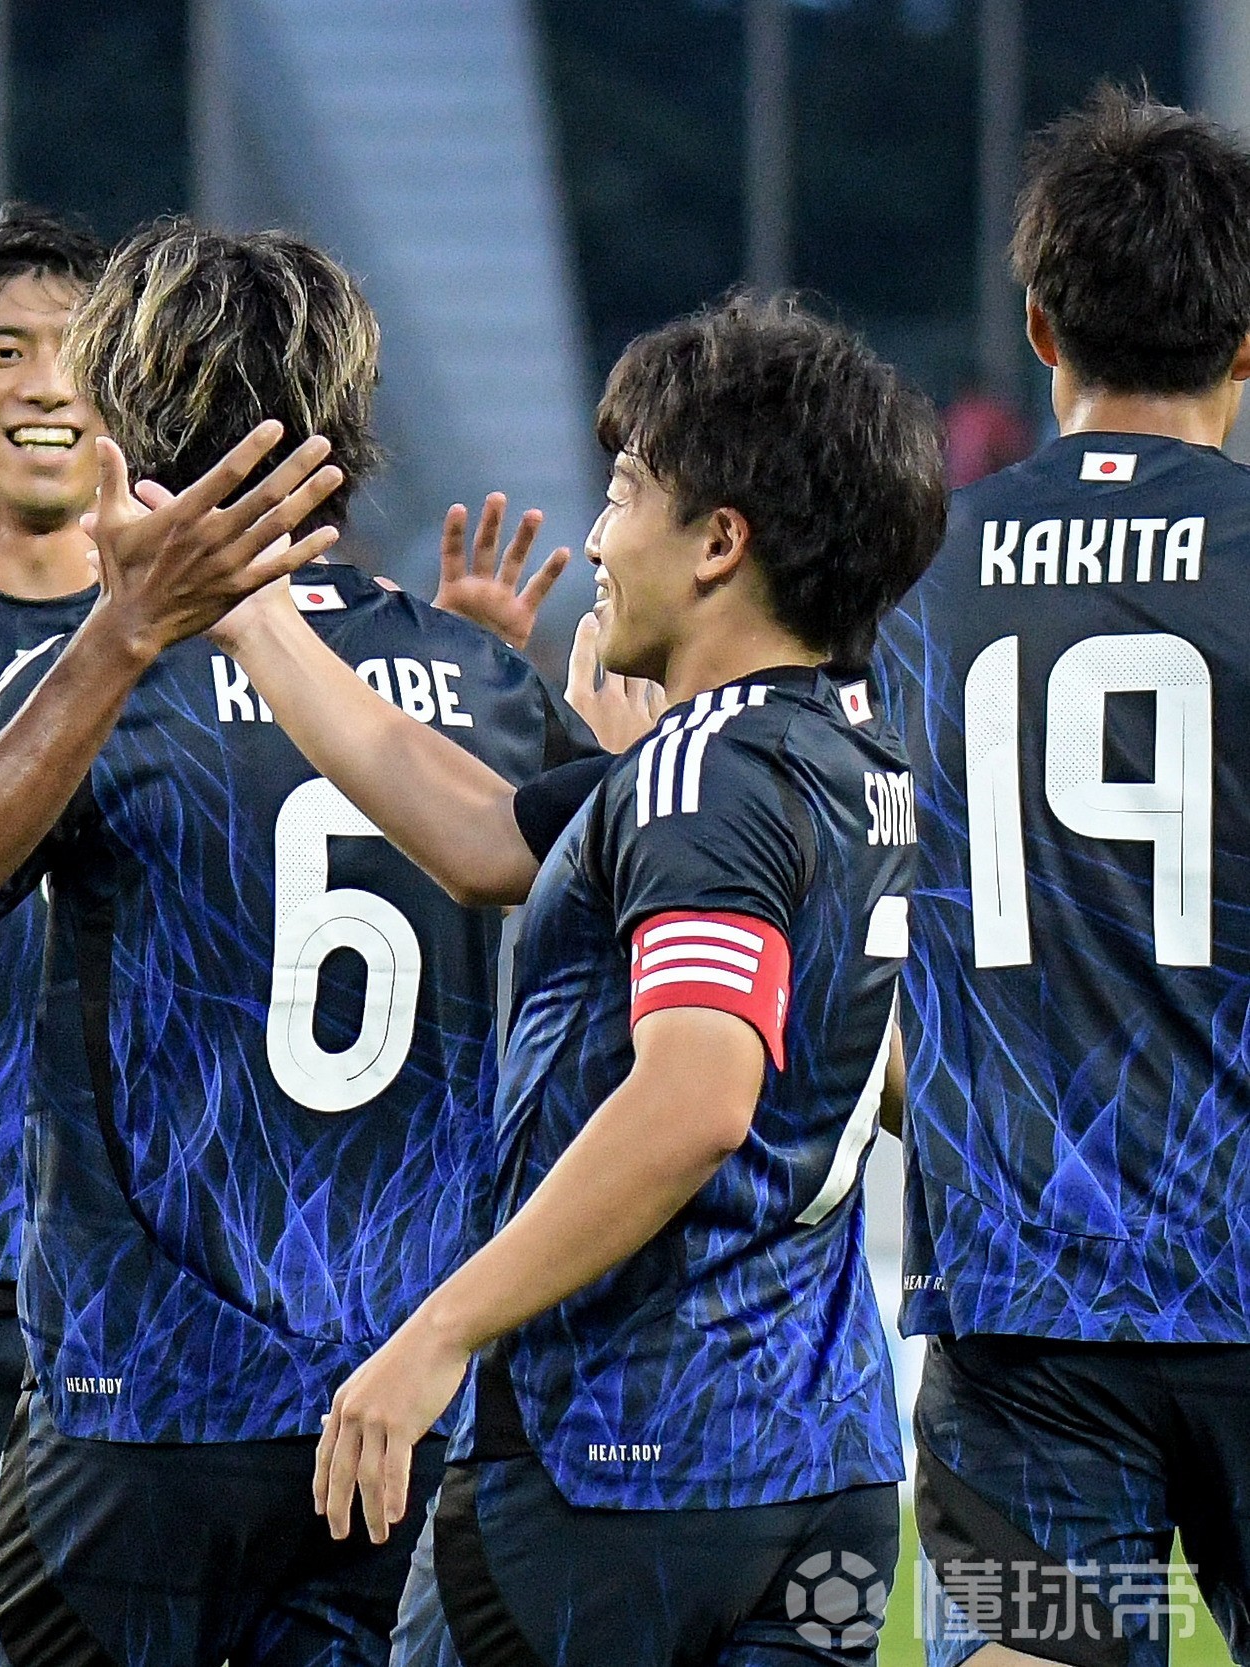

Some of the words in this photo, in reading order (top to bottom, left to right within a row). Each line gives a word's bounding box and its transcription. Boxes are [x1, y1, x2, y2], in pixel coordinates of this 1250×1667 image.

[980, 516, 1205, 586] KAKITA
[210, 655, 474, 728] KABE
[964, 633, 1213, 969] 19
[266, 777, 422, 1112] 6
[588, 1444, 662, 1462] HEAT.RDY
